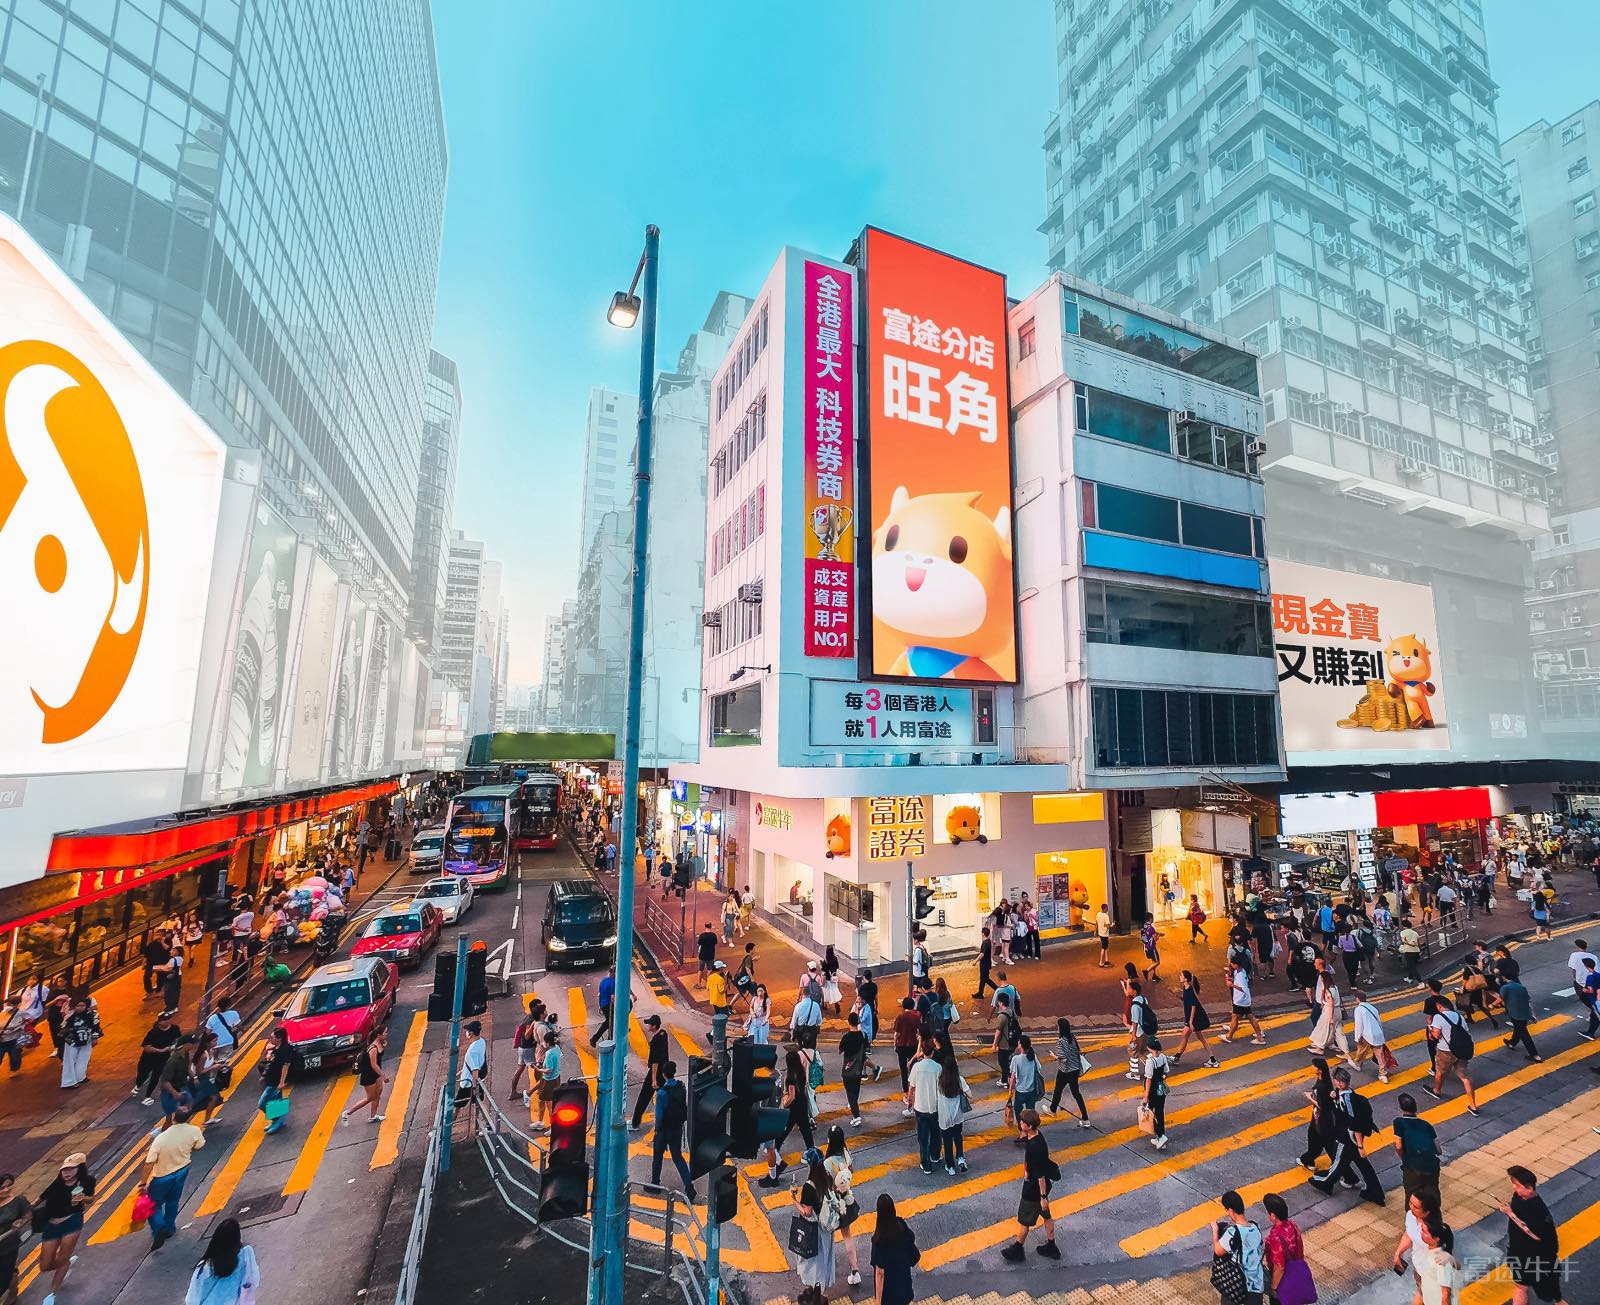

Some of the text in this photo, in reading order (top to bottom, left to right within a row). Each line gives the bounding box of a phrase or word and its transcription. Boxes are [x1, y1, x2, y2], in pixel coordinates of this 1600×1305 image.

[883, 307, 995, 370] 富途分店
[816, 274, 843, 500] 全港最大 科技券商
[883, 354, 998, 443] 旺角
[813, 568, 848, 587] 成交
[814, 631, 848, 647] NO.1
[1271, 593, 1382, 642] 現金寶
[1275, 643, 1385, 686] 又賺到
[870, 796, 924, 825] 富途
[870, 828, 925, 859] 證券
